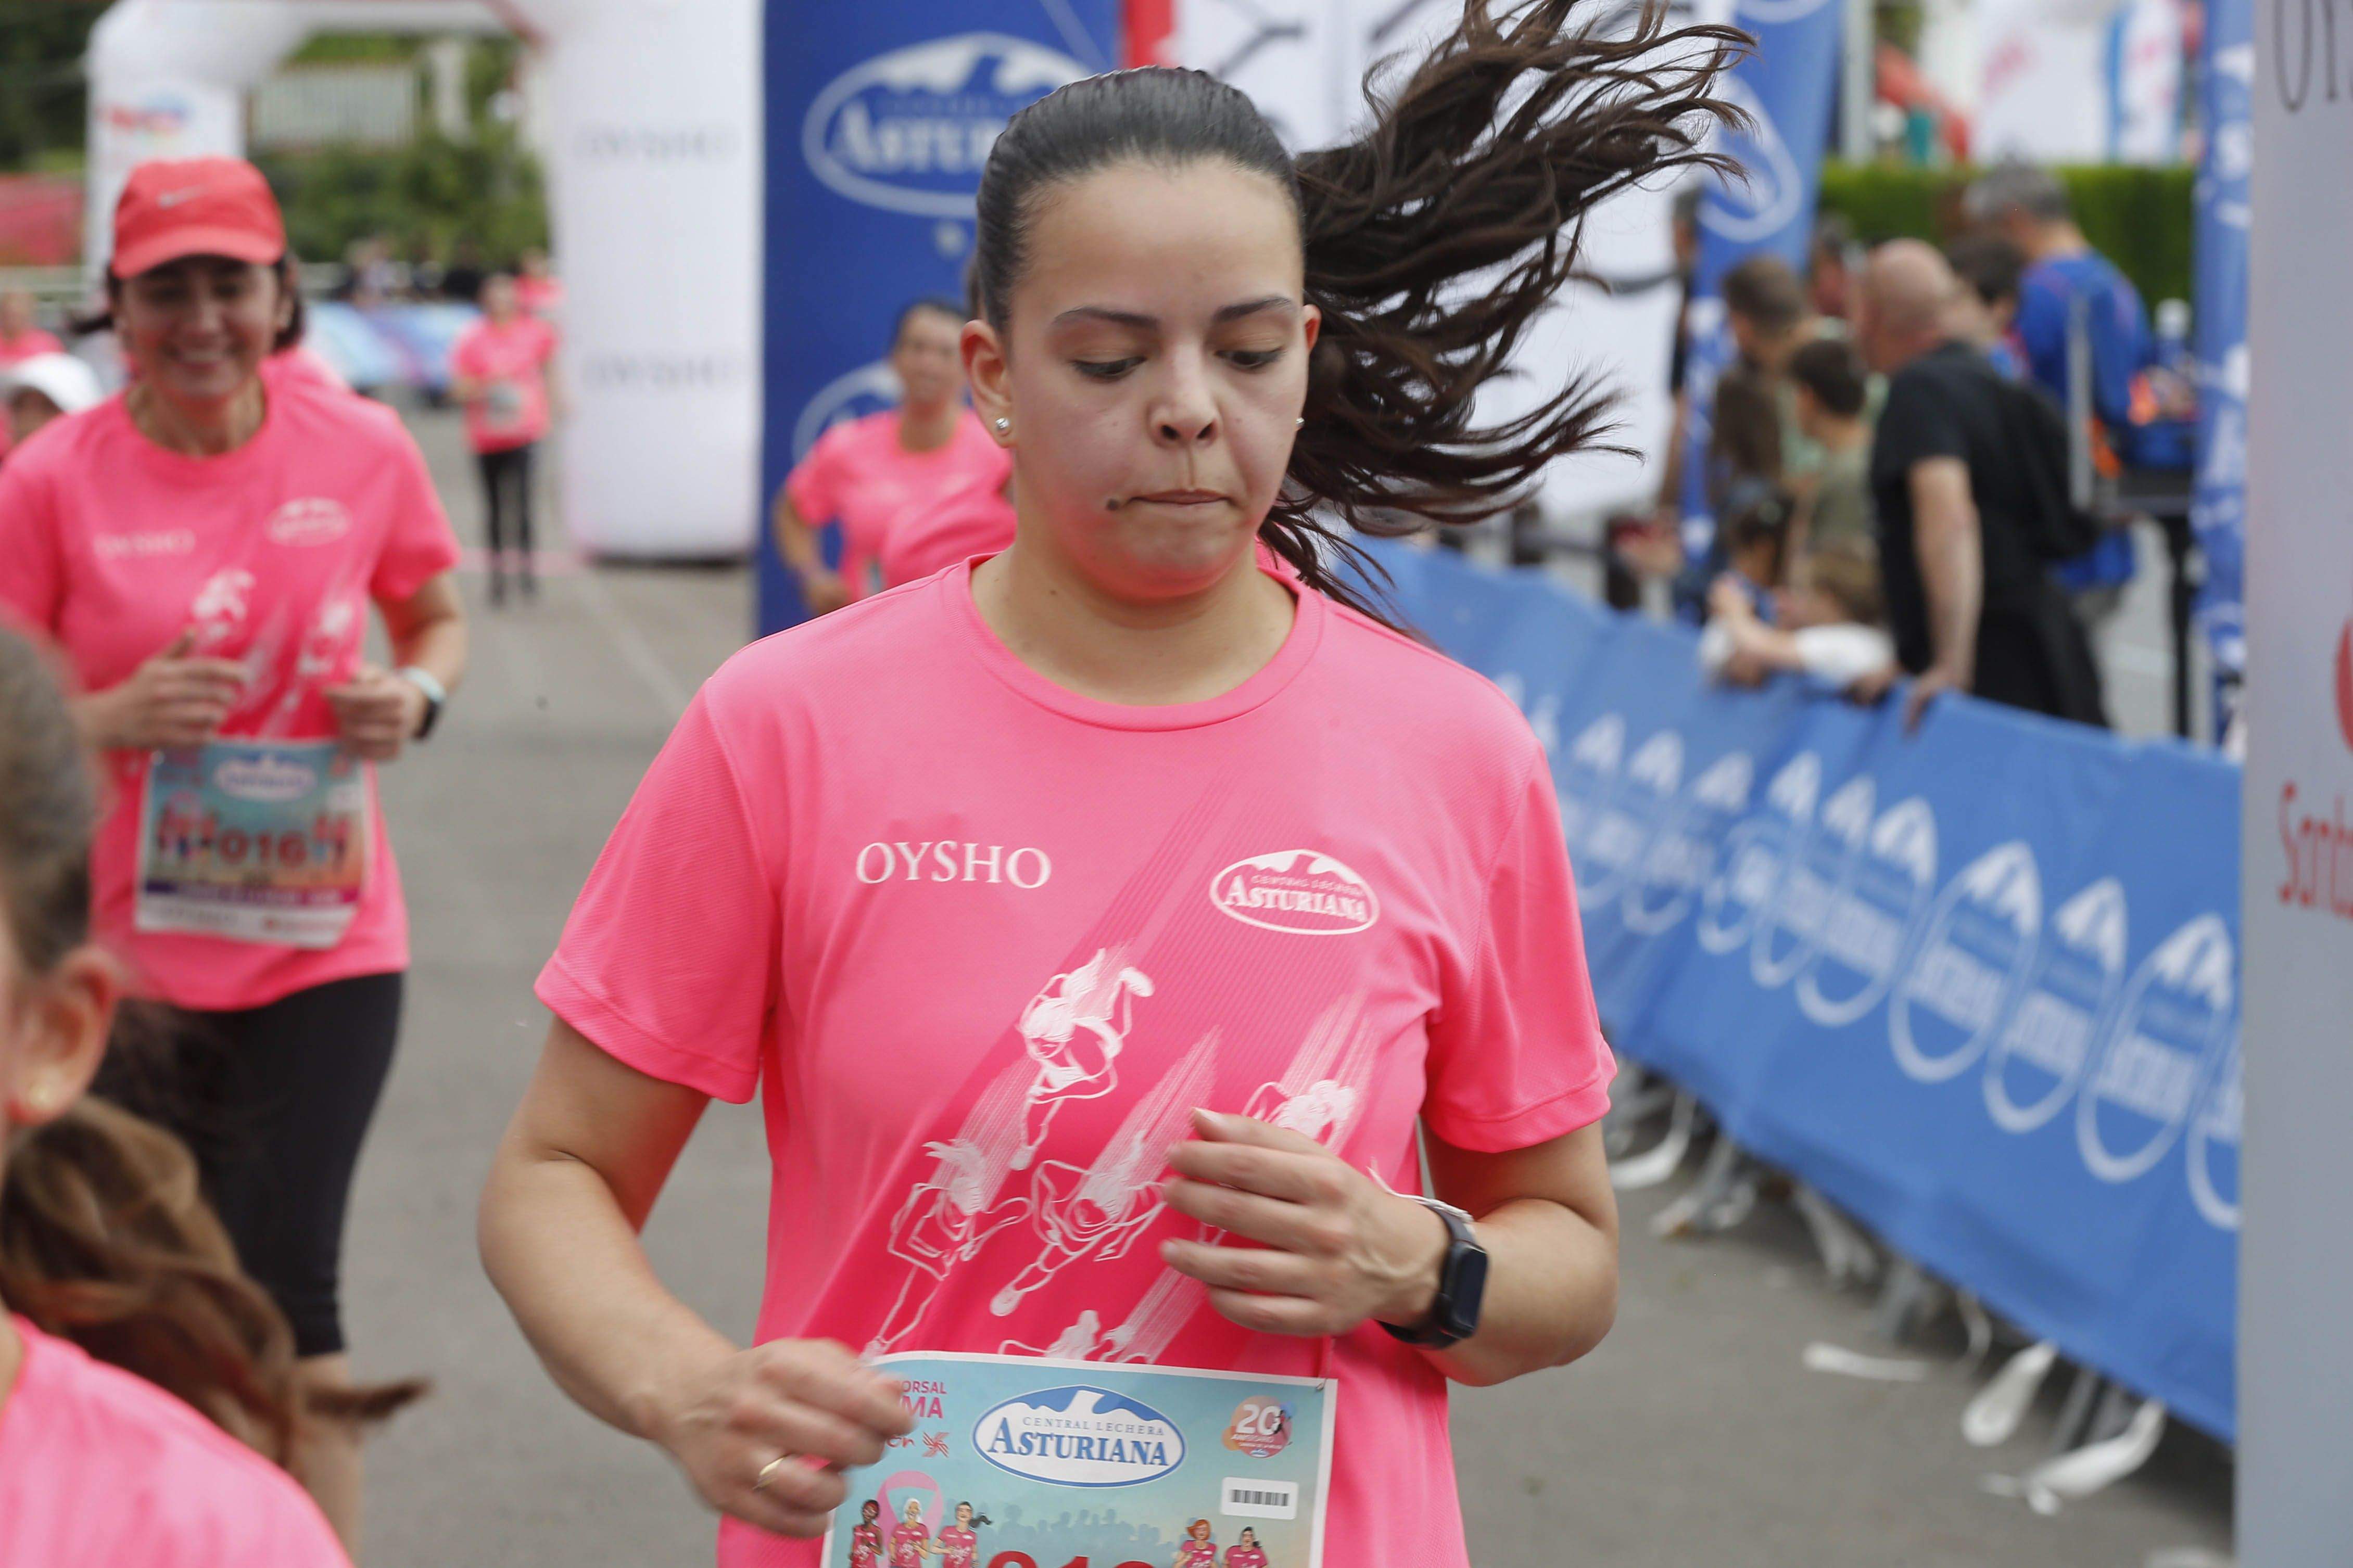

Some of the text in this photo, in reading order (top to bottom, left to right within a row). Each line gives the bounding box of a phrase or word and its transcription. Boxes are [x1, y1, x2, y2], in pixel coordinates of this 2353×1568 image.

[856, 840, 1052, 889] OYSHO
[1223, 875, 1368, 923] ASTURIANA
[902, 1380, 947, 1395] ORSAL
[1022, 1416, 1165, 1436] CENTRAL LECHERA
[1235, 1404, 1282, 1436] 20
[987, 1417, 1169, 1467] ASTURIANA
